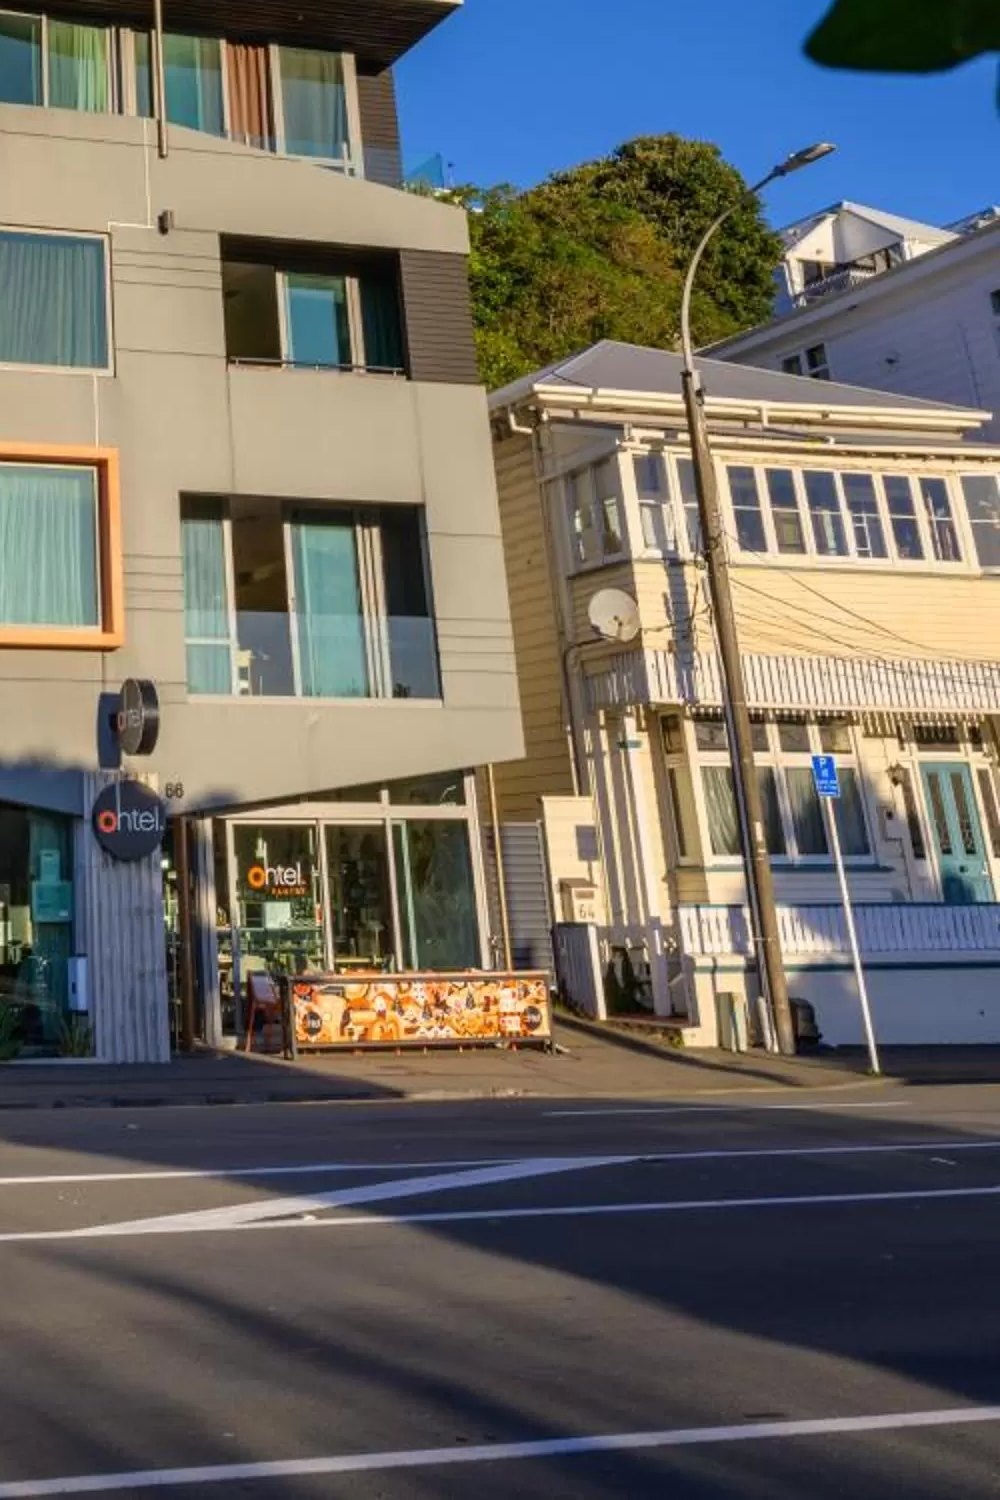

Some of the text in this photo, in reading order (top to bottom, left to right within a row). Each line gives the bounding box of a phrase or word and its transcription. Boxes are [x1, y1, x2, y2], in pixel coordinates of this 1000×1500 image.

[819, 758, 826, 768] P
[165, 782, 184, 799] 66
[579, 903, 595, 919] 64
